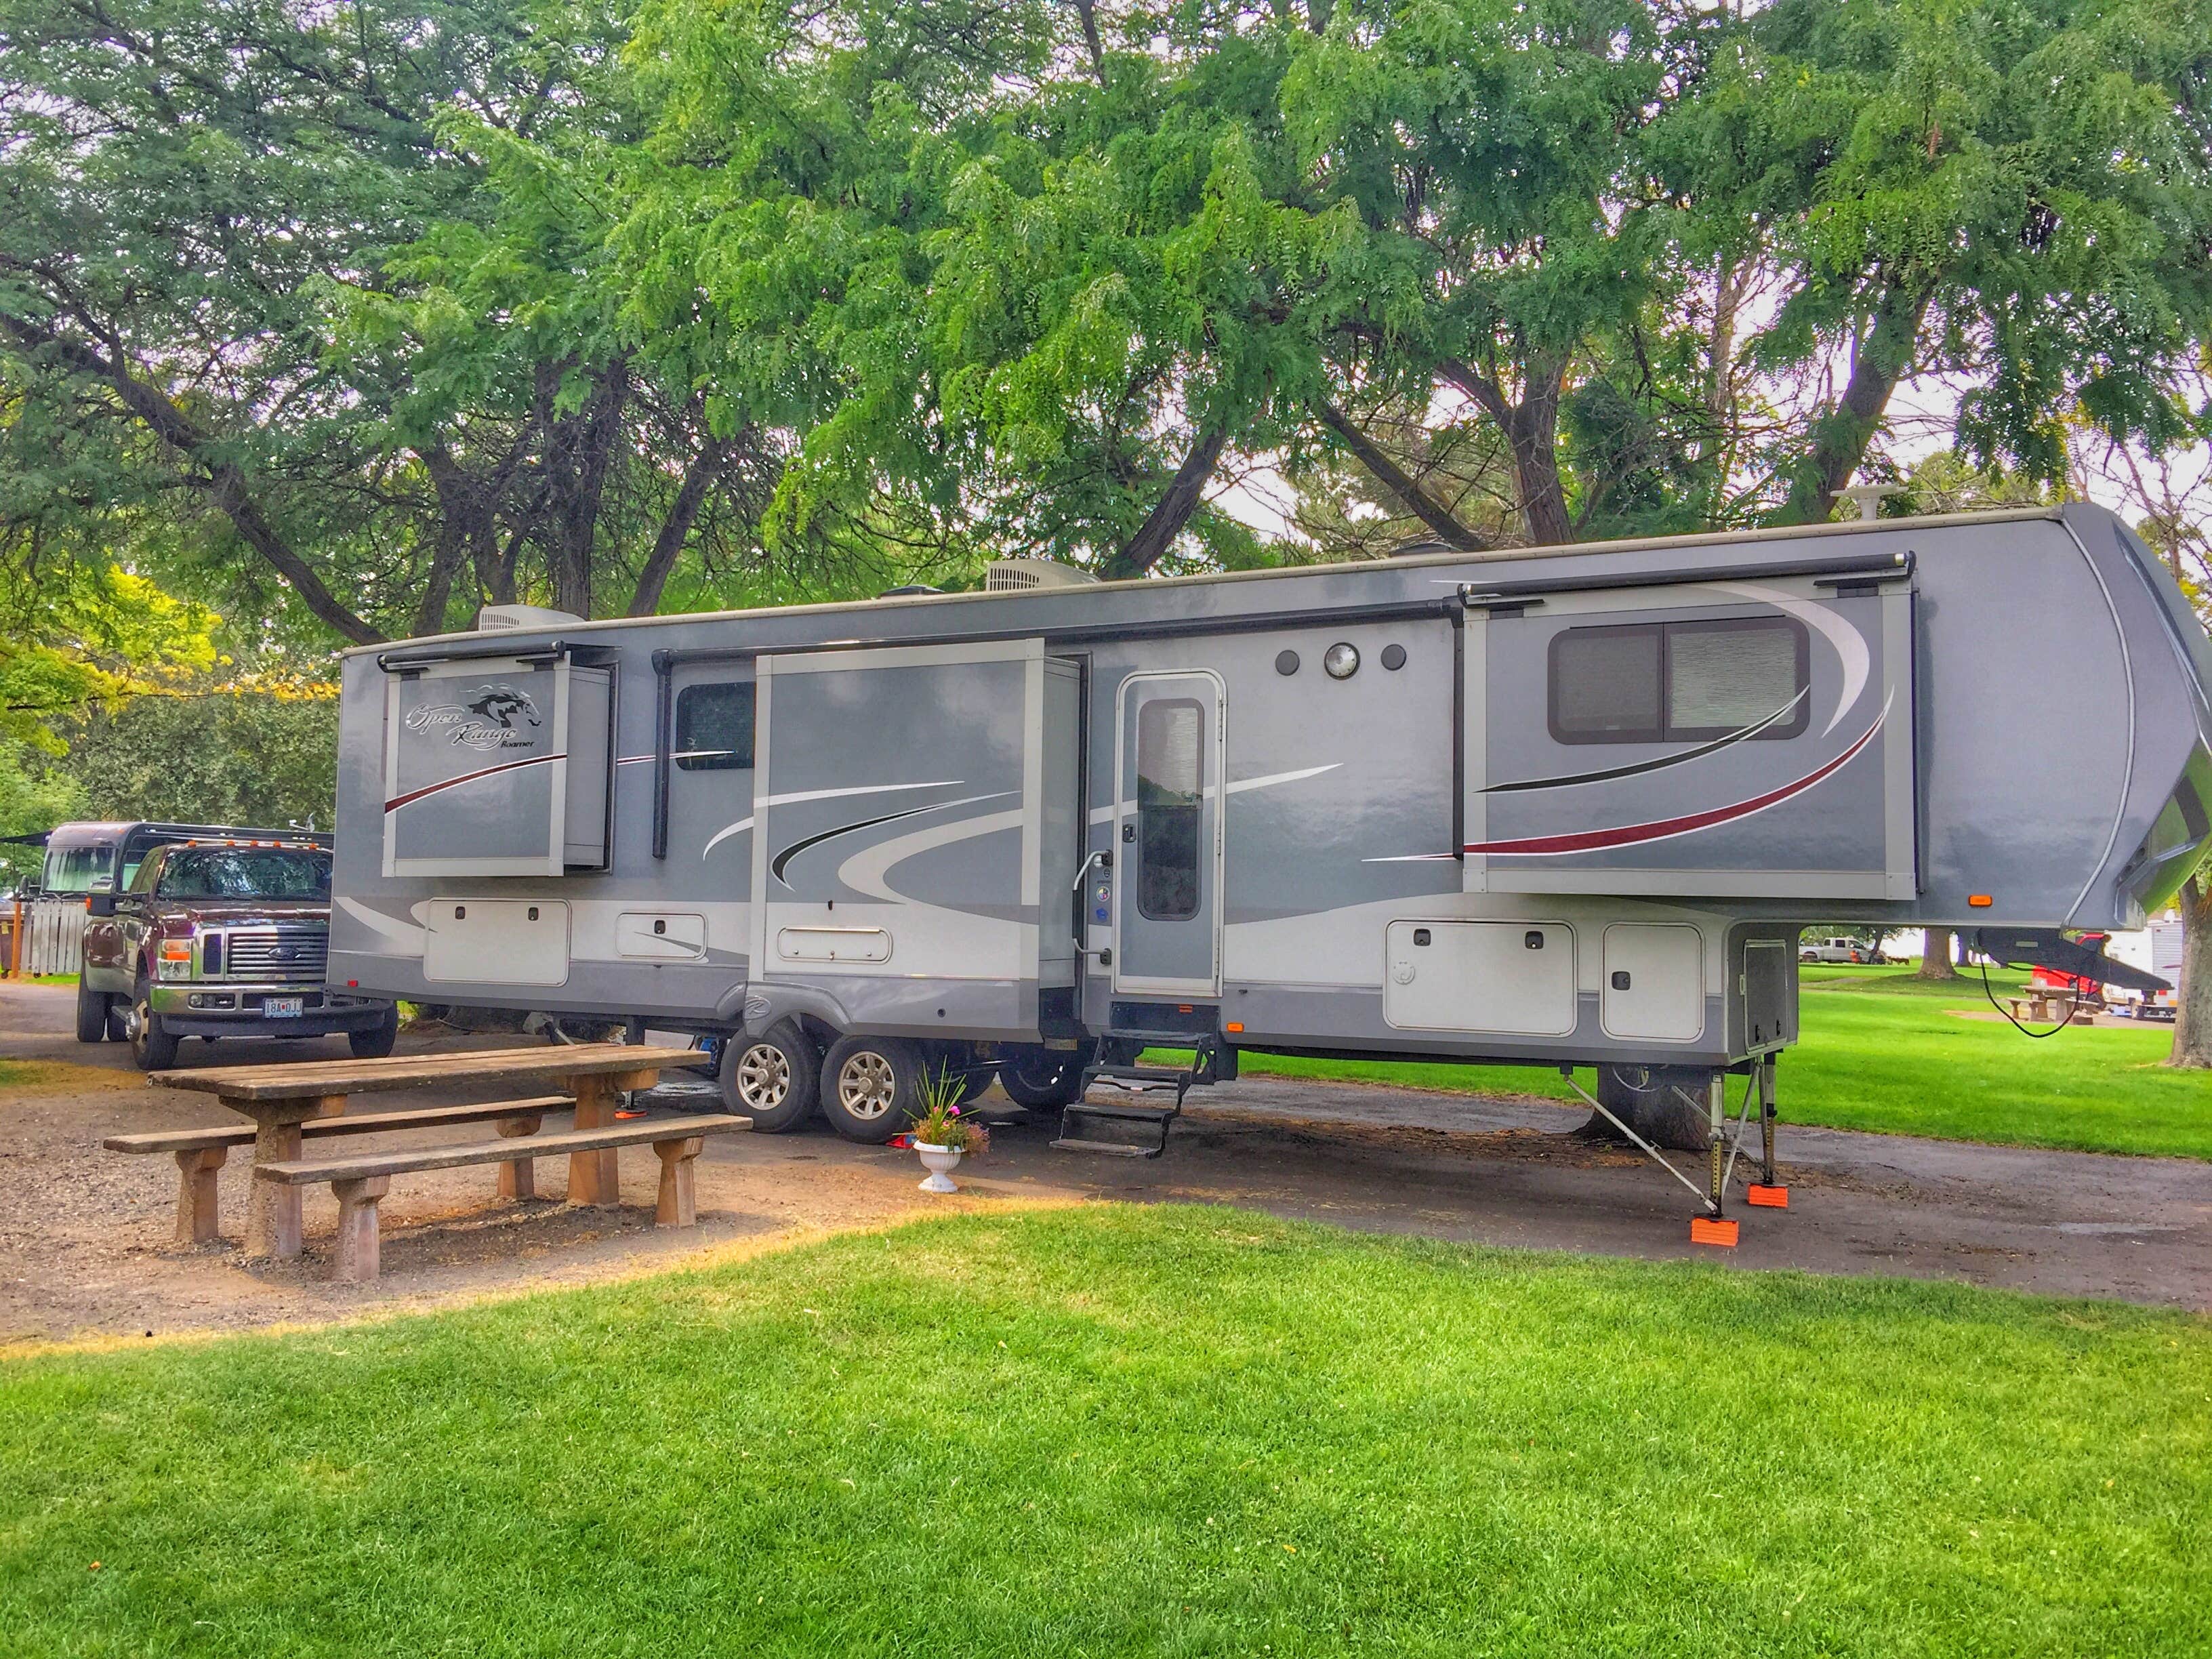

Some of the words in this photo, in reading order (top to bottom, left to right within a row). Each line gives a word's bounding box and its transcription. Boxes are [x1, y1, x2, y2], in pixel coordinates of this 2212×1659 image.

[406, 703, 466, 735] Open
[445, 721, 518, 751] Range
[500, 740, 535, 749] Roamer
